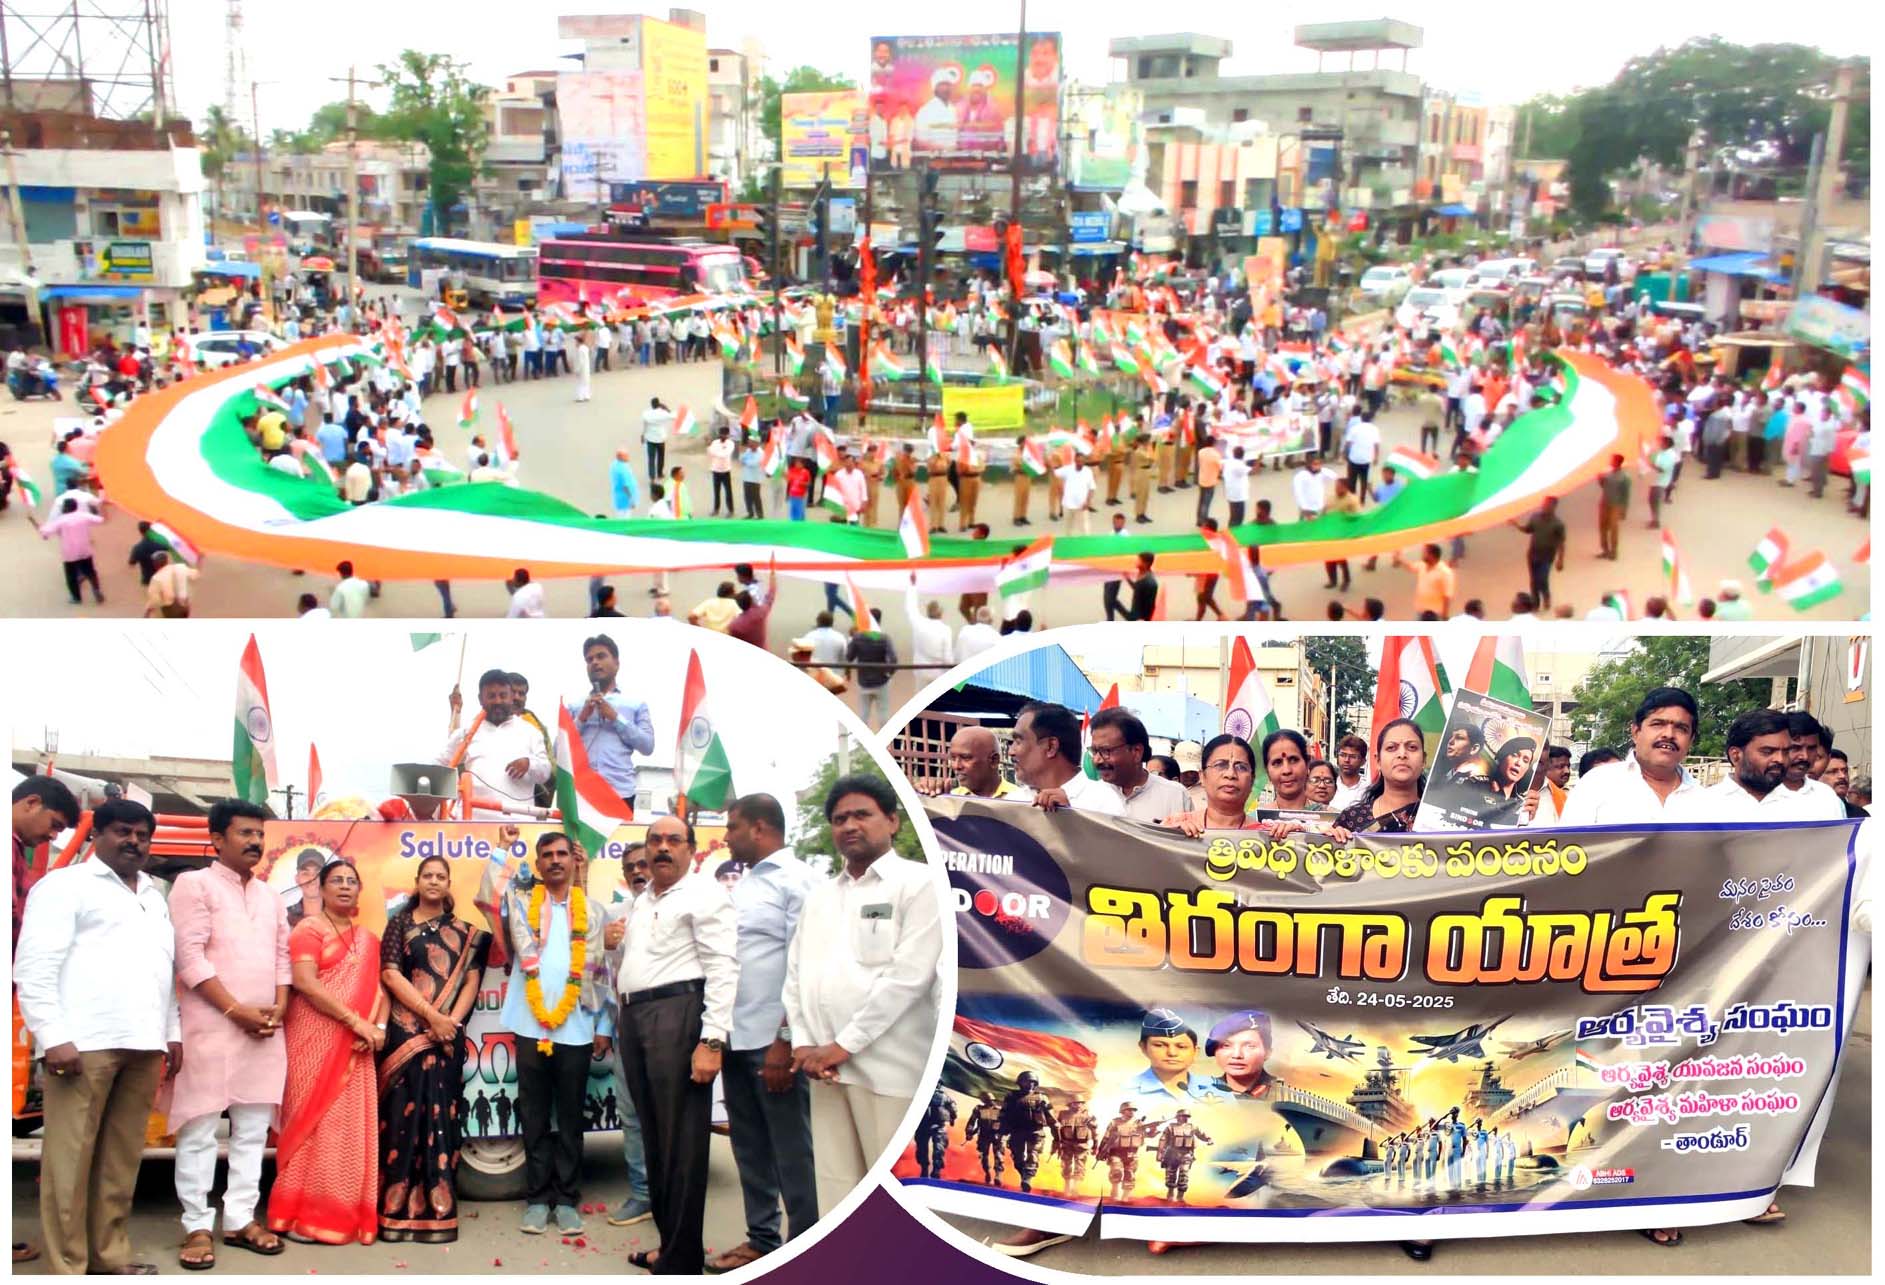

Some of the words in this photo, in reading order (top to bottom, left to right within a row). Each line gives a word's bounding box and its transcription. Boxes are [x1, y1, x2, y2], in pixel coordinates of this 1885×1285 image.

[400, 831, 490, 858] Salute
[511, 841, 528, 858] o
[940, 851, 1014, 875] PERATION
[1205, 838, 1298, 881] త్రివిధ
[1445, 839, 1588, 877] వందనం
[1719, 878, 1757, 905] మనం
[1757, 873, 1794, 901] సైతం
[951, 887, 1051, 919] DOOR
[1729, 907, 1764, 930] దేశం
[1082, 884, 1411, 981] తిరంగా
[1426, 892, 1683, 994] యాత్ర
[1356, 991, 1454, 1008] 24-05-2025
[1722, 1003, 1832, 1033] సంఘం
[1672, 1058, 1743, 1079] యువజన
[1746, 1055, 1804, 1078] సంఘం
[1679, 1092, 1739, 1114] మహిళా
[1741, 1091, 1799, 1114] సంఘం
[1675, 1127, 1748, 1151] తాండూర్
